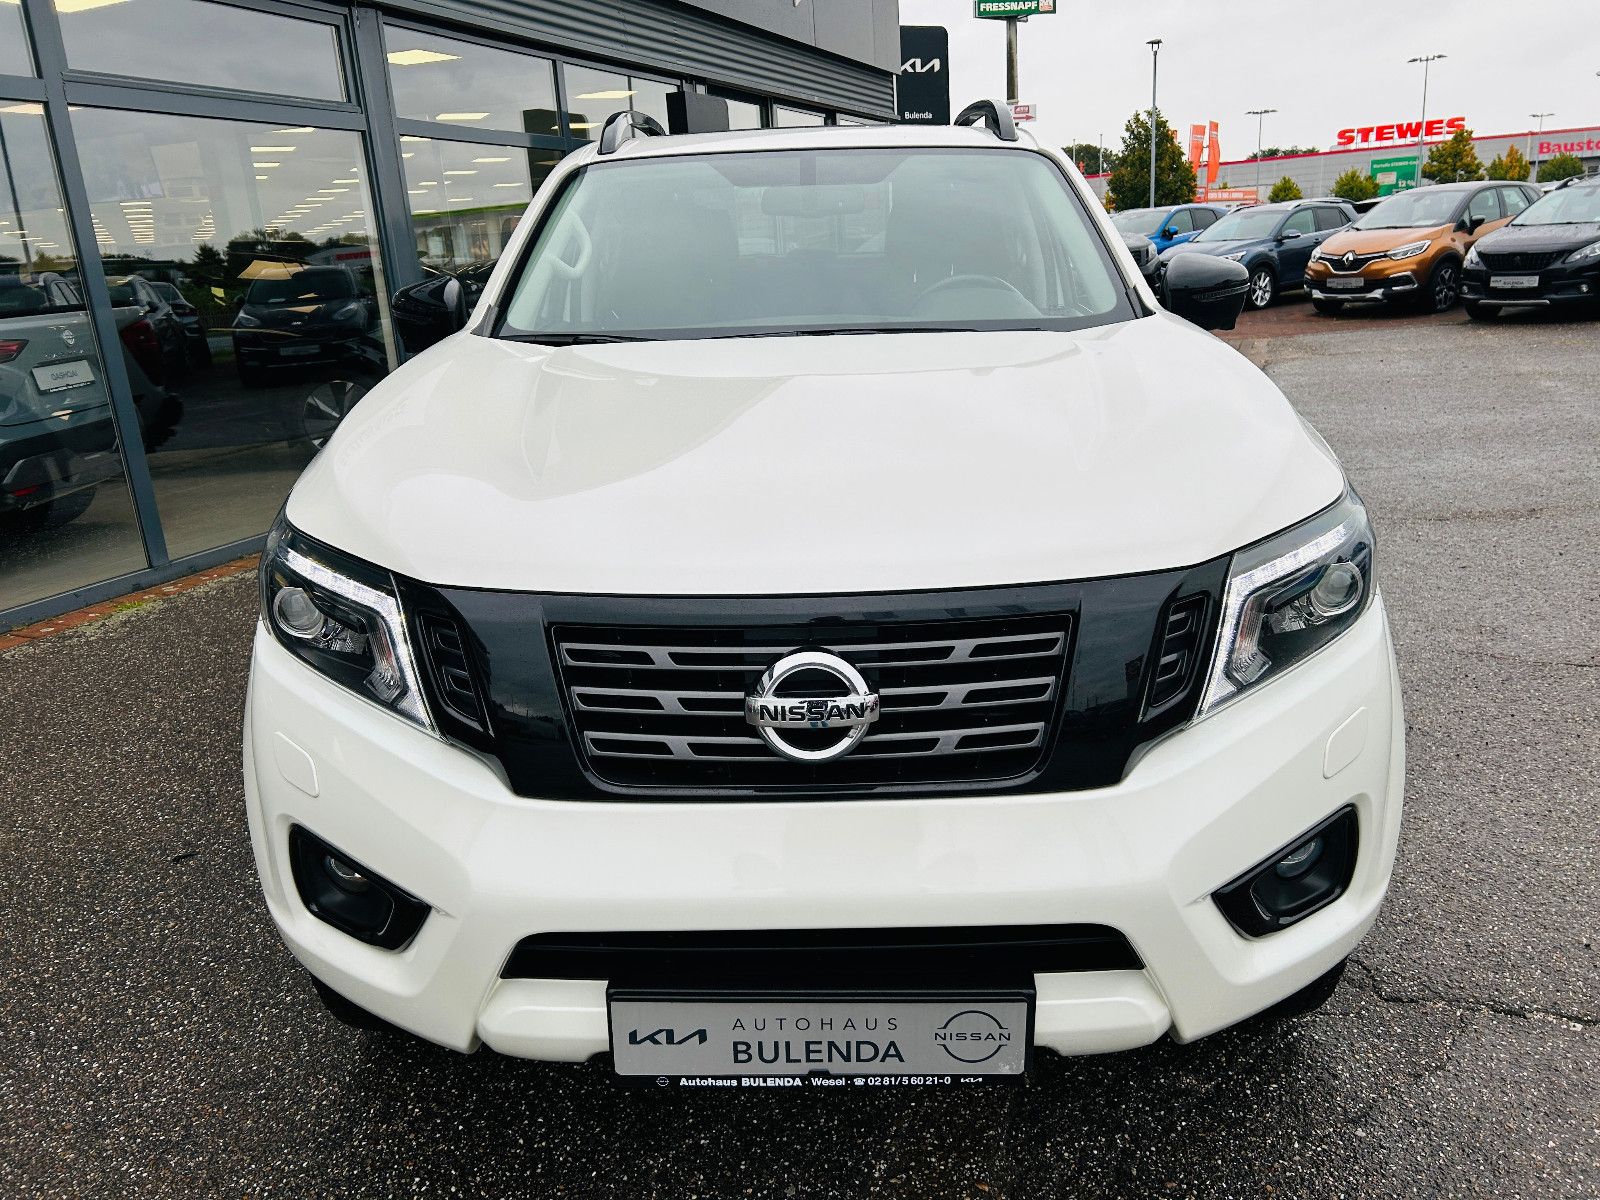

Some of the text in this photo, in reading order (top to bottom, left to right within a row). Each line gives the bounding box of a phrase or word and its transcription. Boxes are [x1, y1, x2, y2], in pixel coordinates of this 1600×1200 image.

[979, 1, 1038, 12] FRESSNAPF
[904, 111, 933, 119] Bulenda
[1336, 116, 1466, 146] STEWES
[759, 702, 866, 722] NISSAN
[732, 1017, 899, 1032] AUTOHAUS
[628, 1028, 708, 1046] KIA
[934, 1031, 1012, 1042] NISSAN
[732, 1040, 906, 1064] BULENDA
[679, 1077, 738, 1087] Autohaus
[741, 1077, 803, 1087] BULENDA
[810, 1077, 846, 1086] Wesel
